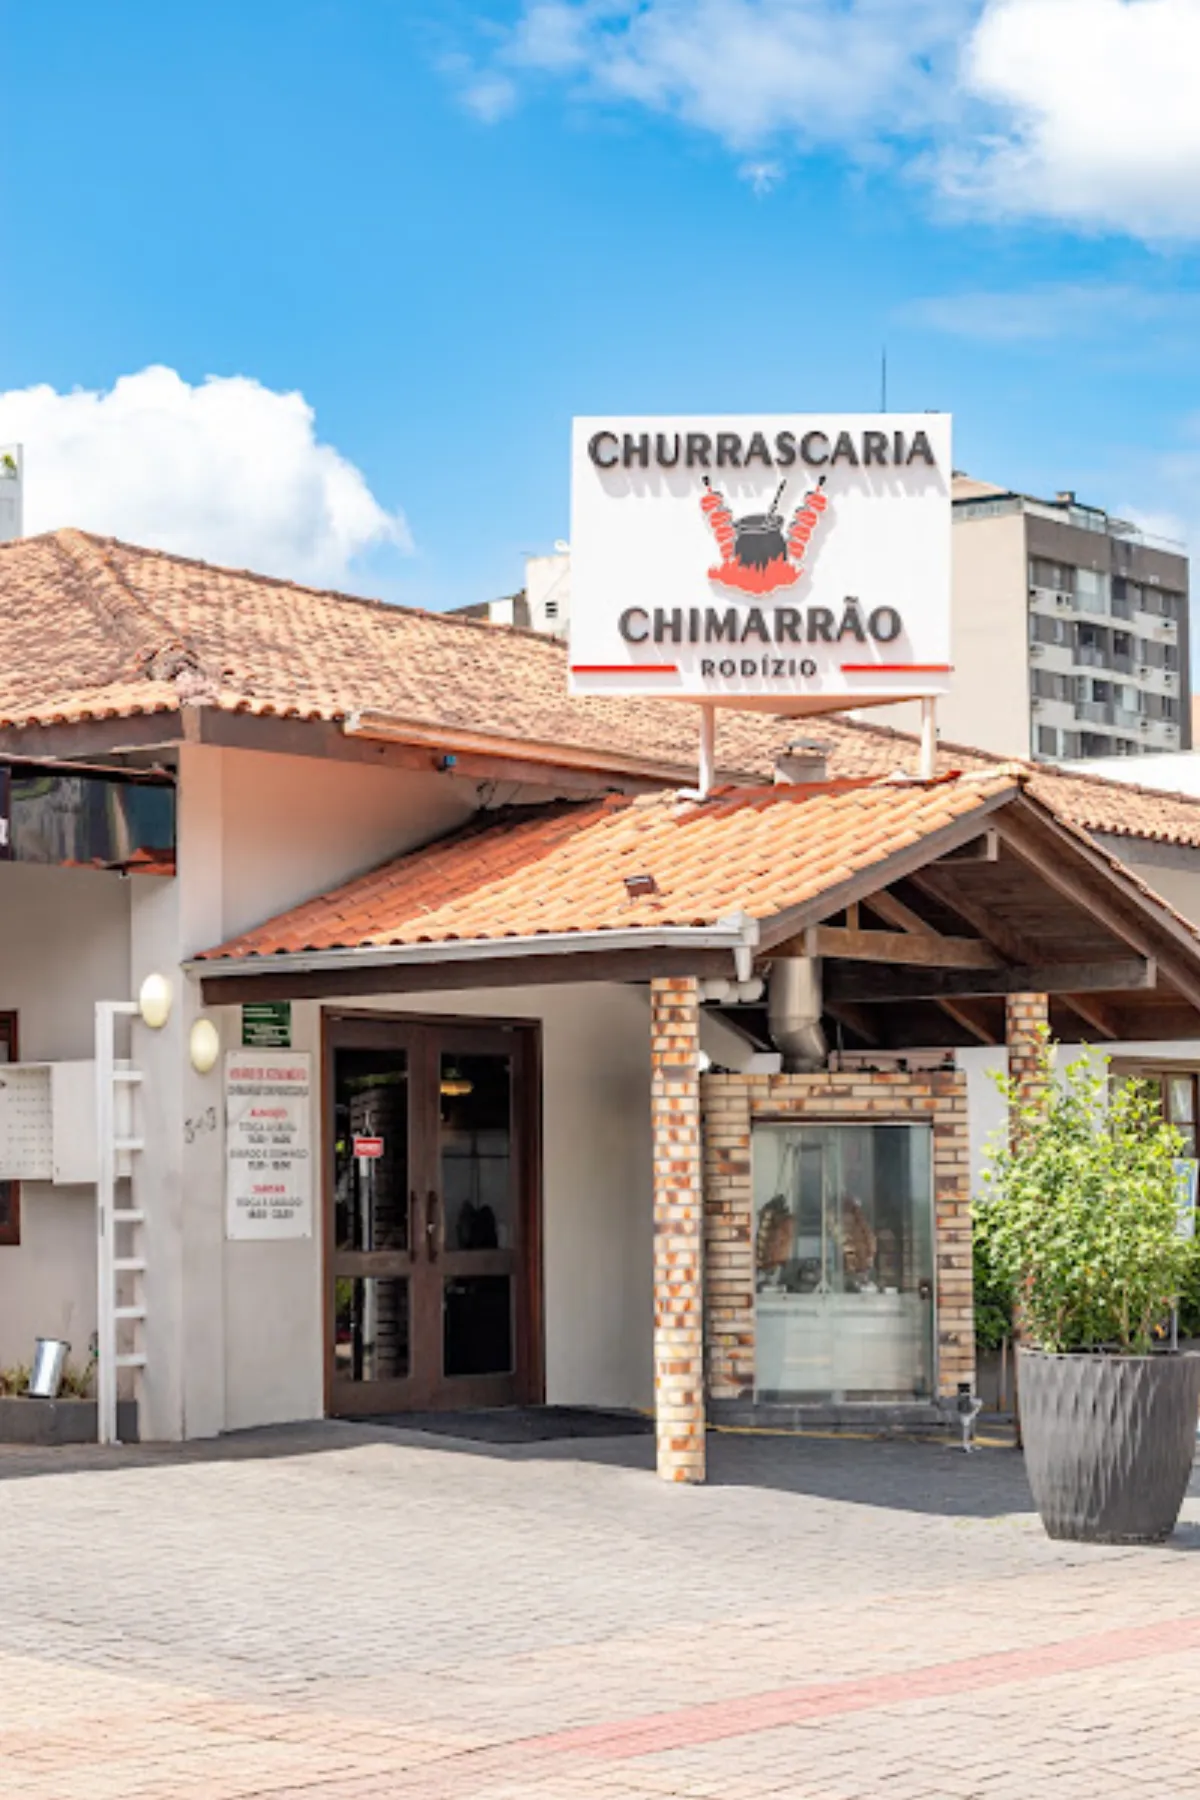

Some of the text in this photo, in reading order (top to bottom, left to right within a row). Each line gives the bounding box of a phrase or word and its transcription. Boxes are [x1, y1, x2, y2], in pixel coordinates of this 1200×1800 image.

[587, 430, 935, 468] CHURRASCARIA
[618, 596, 902, 644] CHIMARRÃO
[700, 654, 818, 678] RODÍZIO
